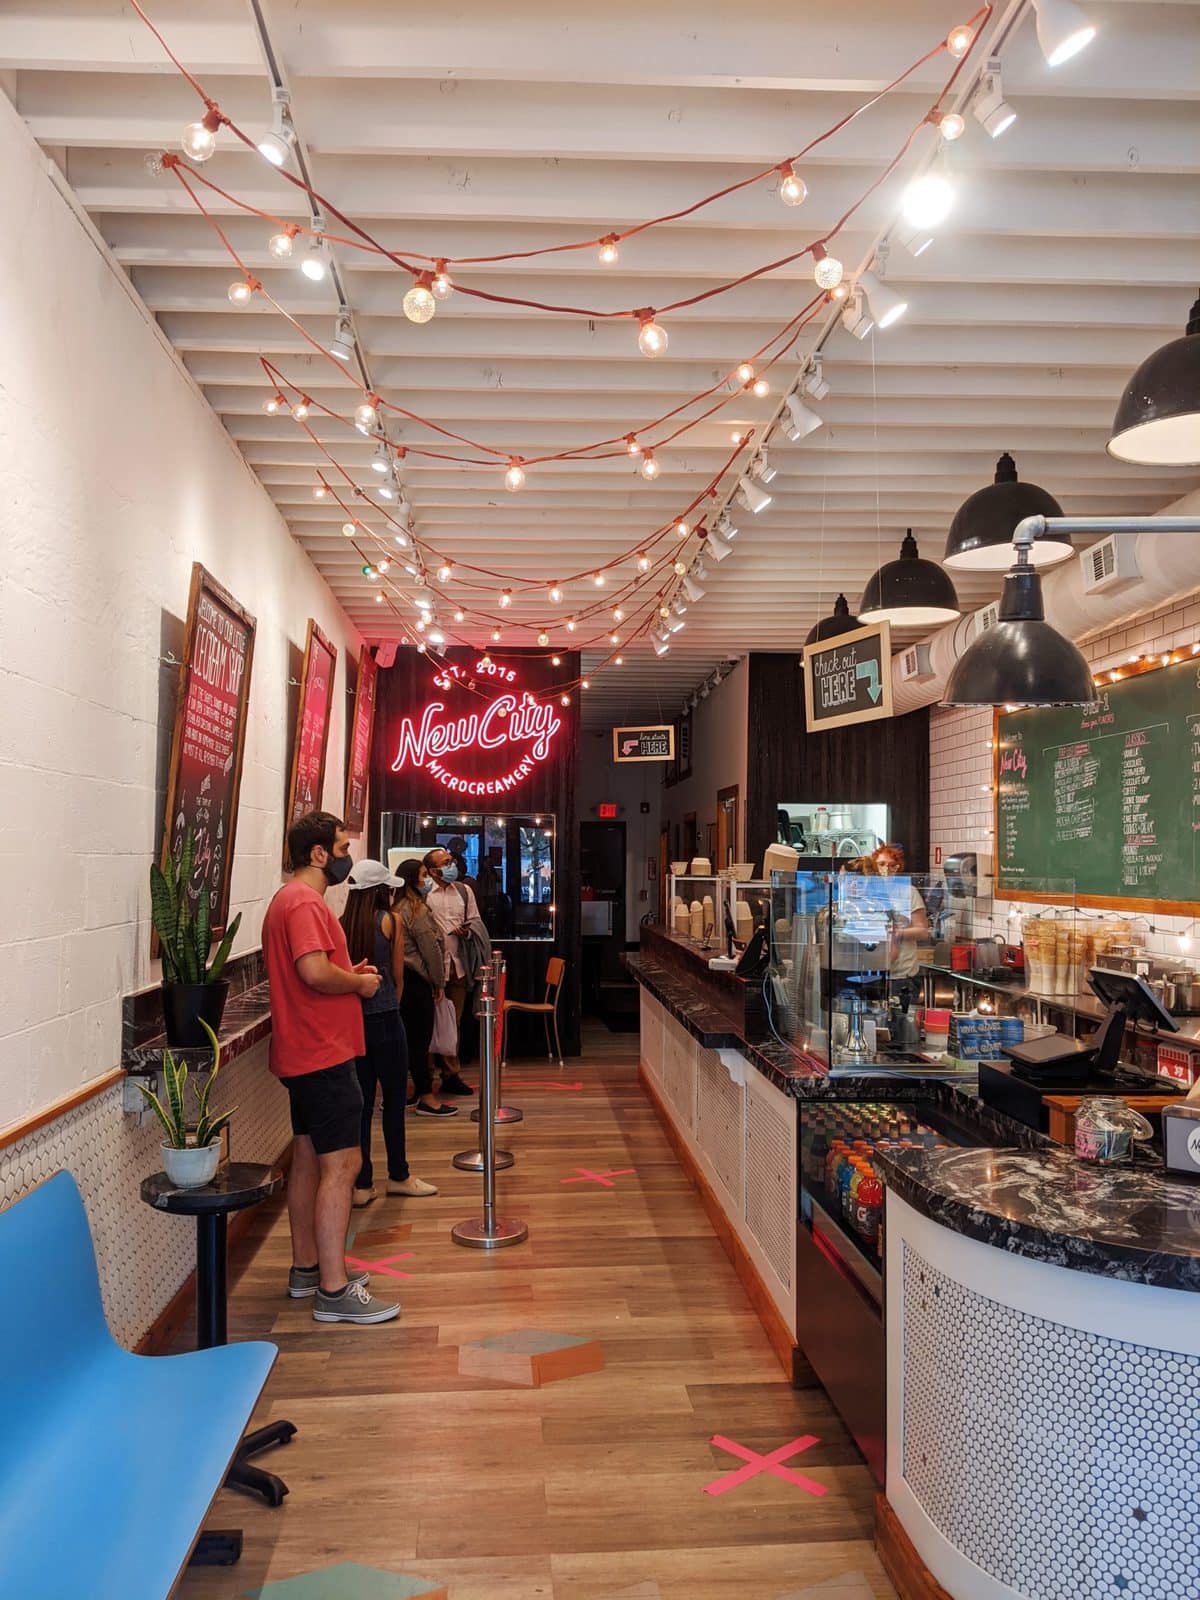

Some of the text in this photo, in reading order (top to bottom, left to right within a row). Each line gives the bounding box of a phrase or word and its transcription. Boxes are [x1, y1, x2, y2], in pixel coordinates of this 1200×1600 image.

[202, 630, 228, 691] CREAM
[226, 647, 245, 697] SHOP
[814, 647, 857, 677] check out
[821, 669, 857, 708] HERE
[391, 702, 478, 772] New
[478, 692, 561, 760] City
[640, 741, 668, 755] HERE
[426, 755, 535, 795] MICROCREAMERY
[857, 1206, 867, 1221] G
